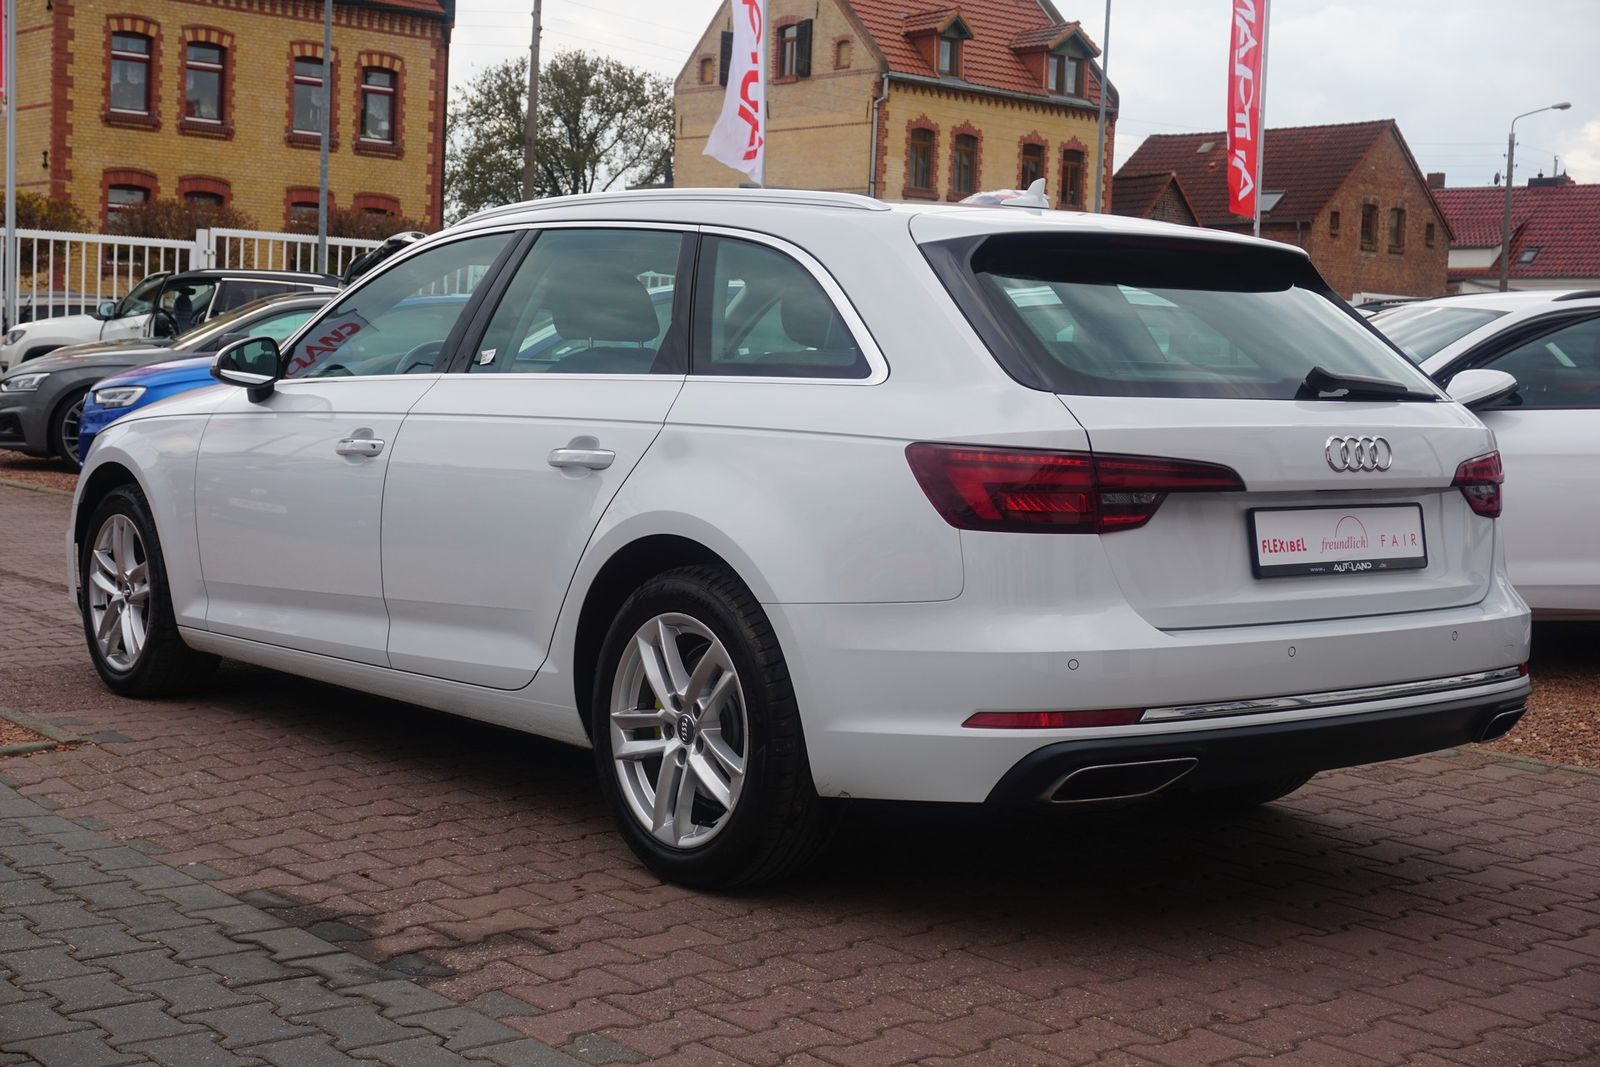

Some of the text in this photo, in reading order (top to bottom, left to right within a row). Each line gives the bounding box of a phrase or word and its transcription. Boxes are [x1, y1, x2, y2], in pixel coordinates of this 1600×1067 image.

[1261, 537, 1308, 554] FLEXIBEL
[1320, 535, 1367, 555] freundlich
[1333, 562, 1372, 573] AUTOLAND
